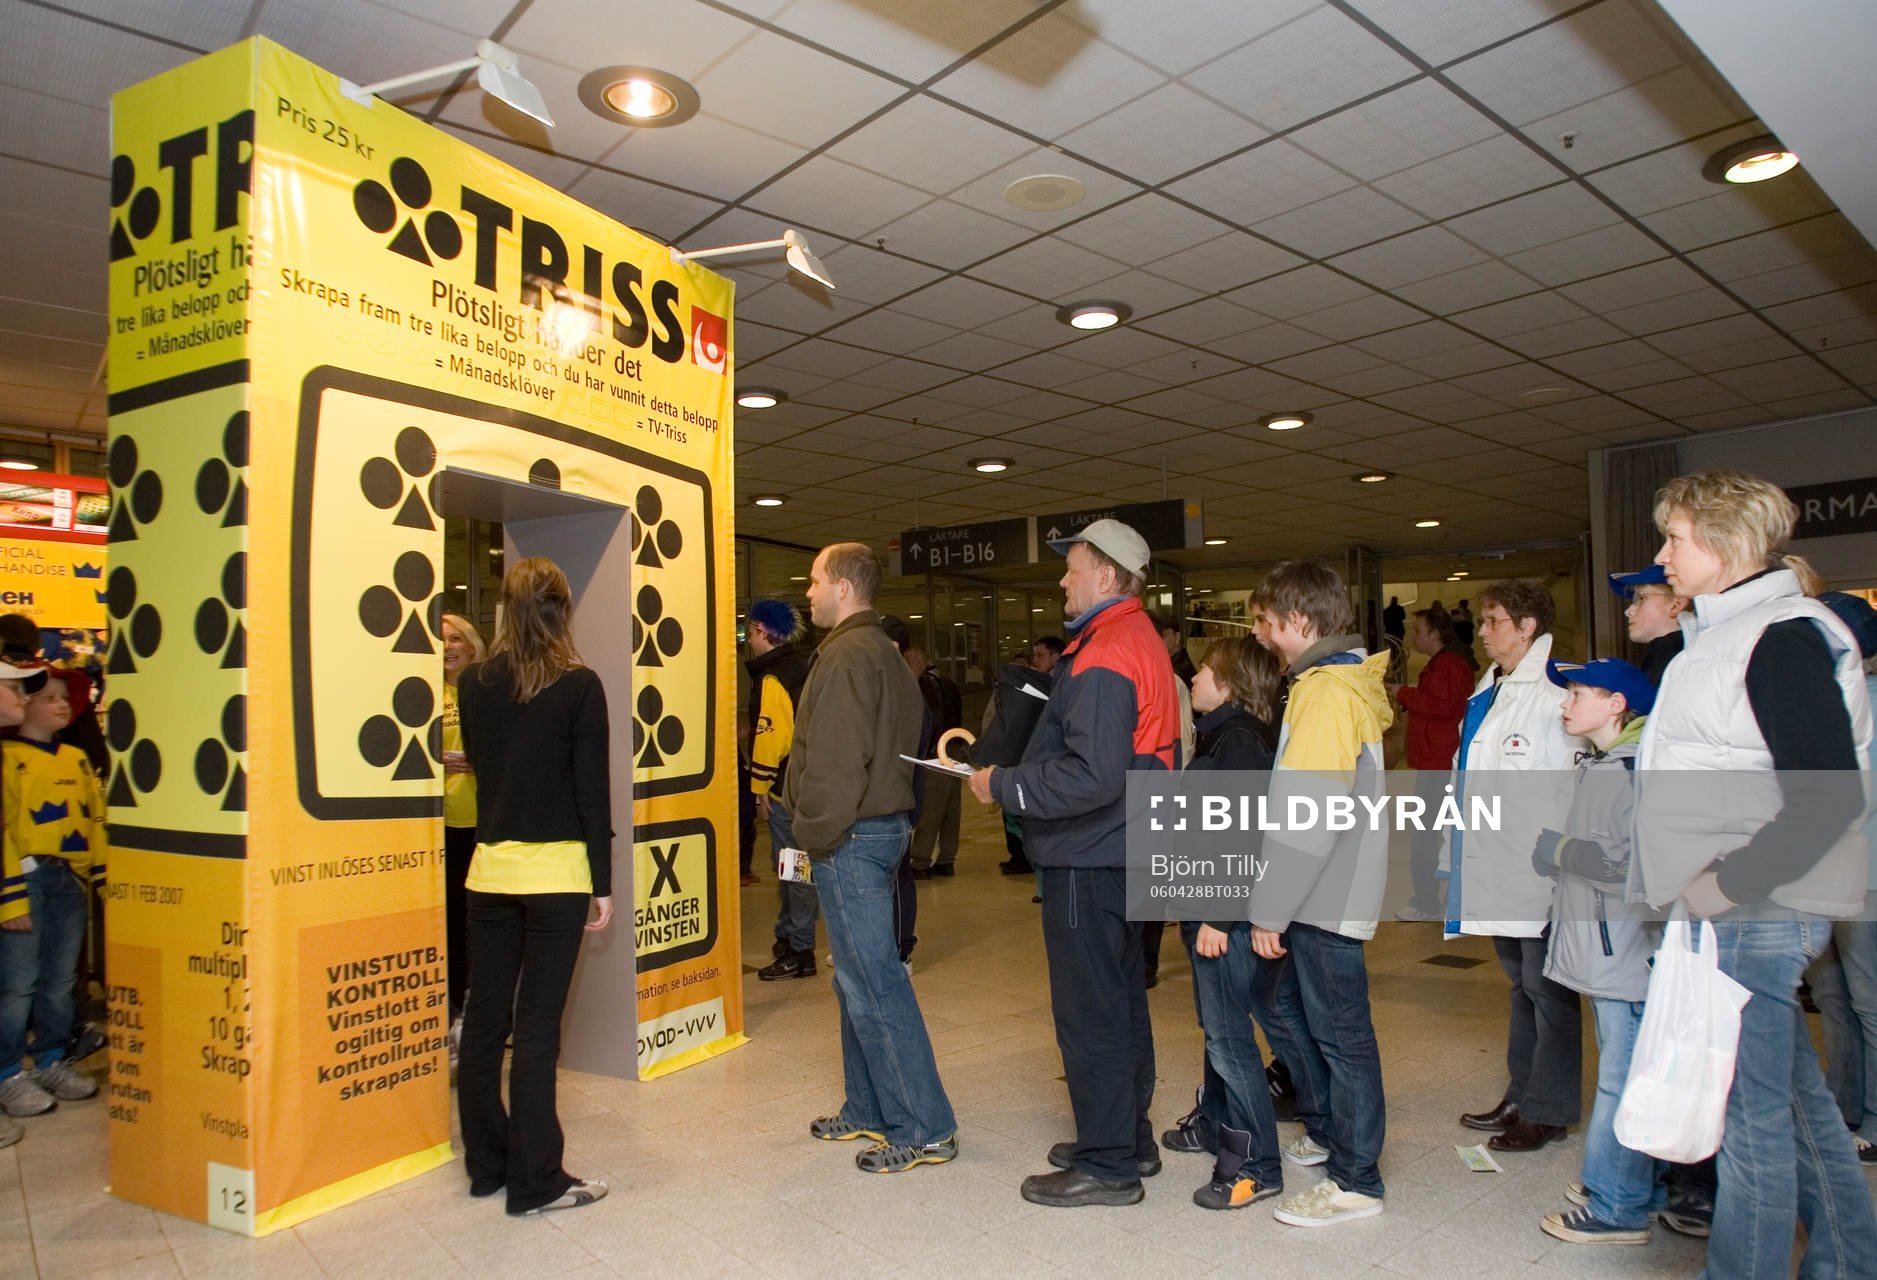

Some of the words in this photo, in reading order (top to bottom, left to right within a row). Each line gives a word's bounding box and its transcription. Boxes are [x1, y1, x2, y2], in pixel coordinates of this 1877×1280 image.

[278, 96, 317, 134] Pris
[322, 120, 349, 148] 25
[354, 133, 375, 161] kr
[134, 246, 219, 298] Plötsligt
[461, 184, 685, 364] TRISS
[116, 316, 135, 334] tre
[141, 304, 165, 327] lika
[172, 294, 220, 318] belopp
[432, 279, 525, 343] Plötsligt
[614, 349, 642, 382] det
[148, 318, 251, 357] Månadsklöver
[280, 267, 350, 308] Skrapa
[358, 293, 401, 325] fram
[409, 313, 433, 336] tre
[440, 320, 468, 348] lika
[476, 333, 526, 370] belopp
[533, 358, 558, 378] och
[564, 364, 580, 384] du
[585, 370, 605, 393] har
[610, 384, 646, 407] vunnit
[650, 396, 678, 418] detta
[683, 405, 719, 433] belopp
[450, 354, 555, 401] Månadsklöver
[647, 418, 687, 443] TV-Triss
[271, 863, 314, 886] VINST
[318, 856, 374, 880] INLÖSES
[377, 851, 426, 873] SENAST
[649, 842, 682, 898] X
[140, 885, 157, 902] FEB
[159, 887, 183, 904] 2007
[635, 897, 699, 928] GÅNGER
[635, 917, 700, 949] VINSTEN
[326, 947, 444, 984] VINSTUTB.
[671, 978, 680, 990] se
[682, 966, 721, 987] baksidan.
[326, 968, 446, 1009] KONTROLL
[209, 1016, 228, 1040] 10
[327, 995, 419, 1032] Vinstlott
[426, 990, 446, 1008] är
[335, 1024, 403, 1054] ogiltig
[410, 1015, 439, 1034] om
[201, 1045, 250, 1083] Skrap
[340, 1056, 437, 1101] skrapats!
[221, 1187, 246, 1214] 12
